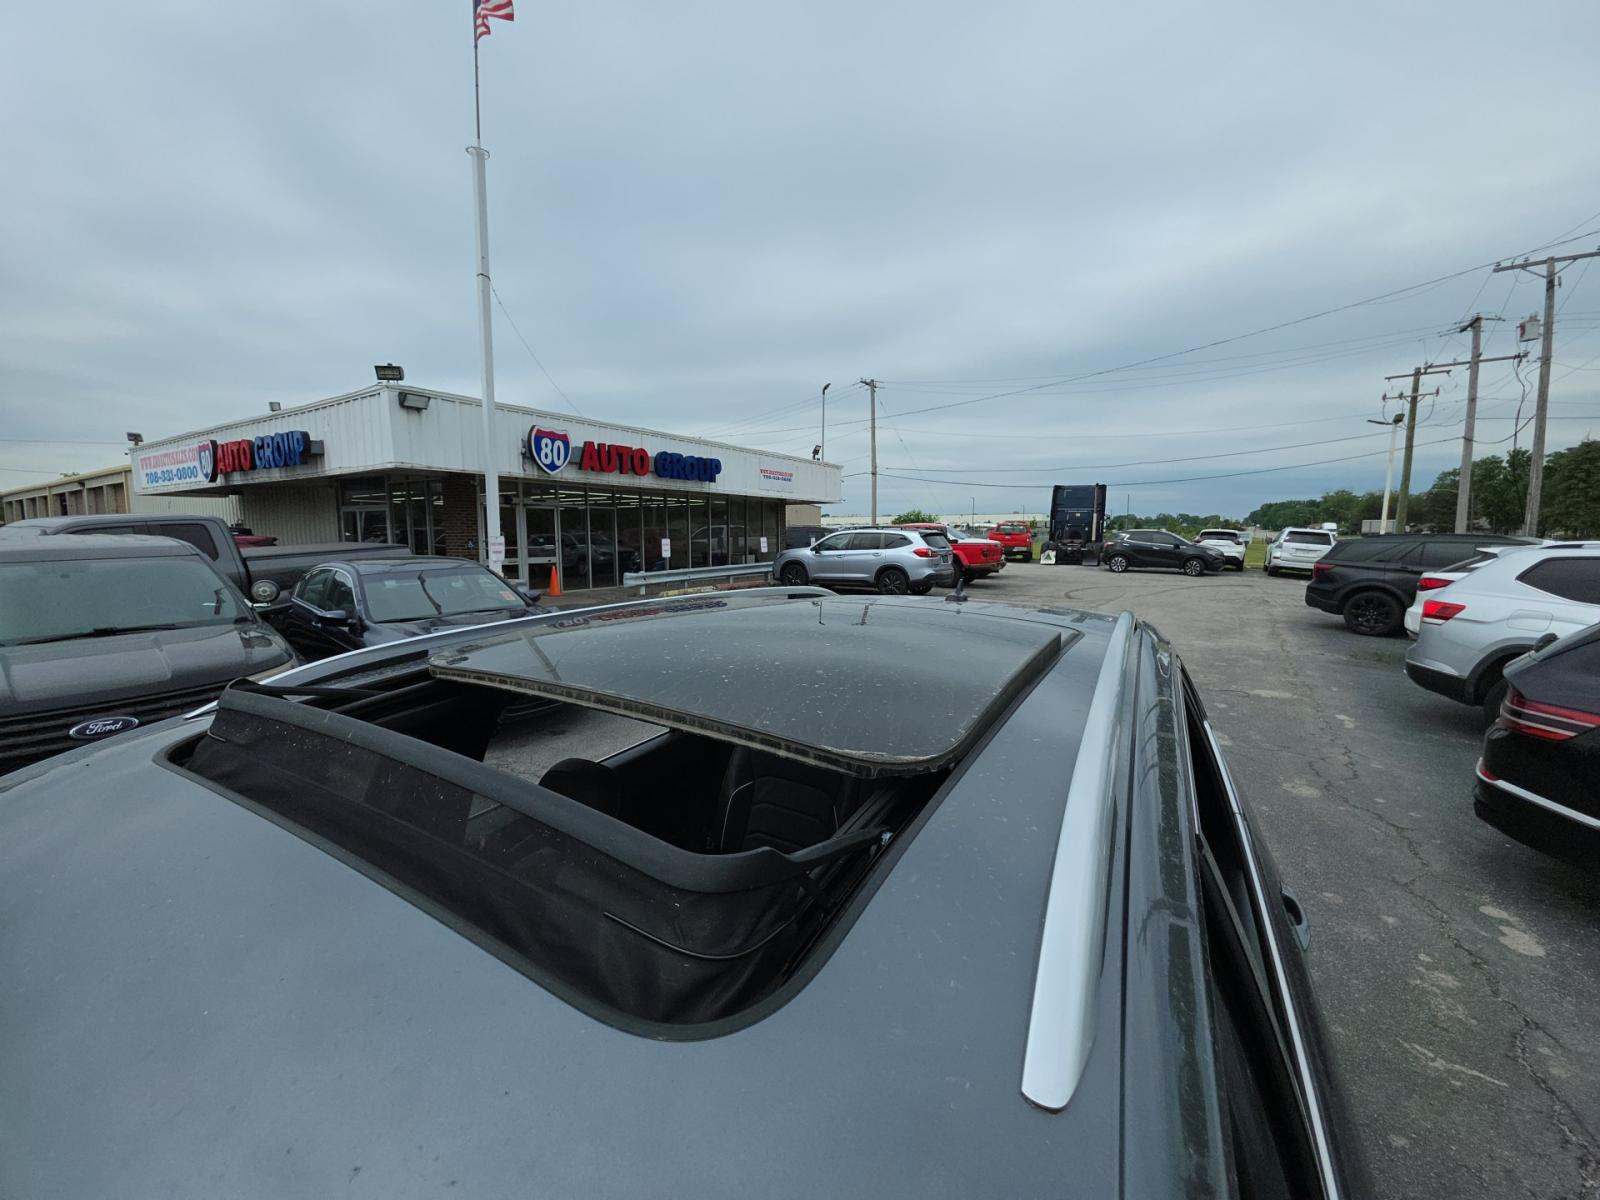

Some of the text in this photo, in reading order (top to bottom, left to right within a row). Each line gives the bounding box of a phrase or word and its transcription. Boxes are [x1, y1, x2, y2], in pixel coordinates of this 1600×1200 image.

[200, 449, 211, 475] 80
[217, 439, 252, 474] AUTO
[254, 431, 307, 469] GROUP
[540, 438, 722, 482] 80 AUTO GROUP
[86, 720, 123, 735] Ford
